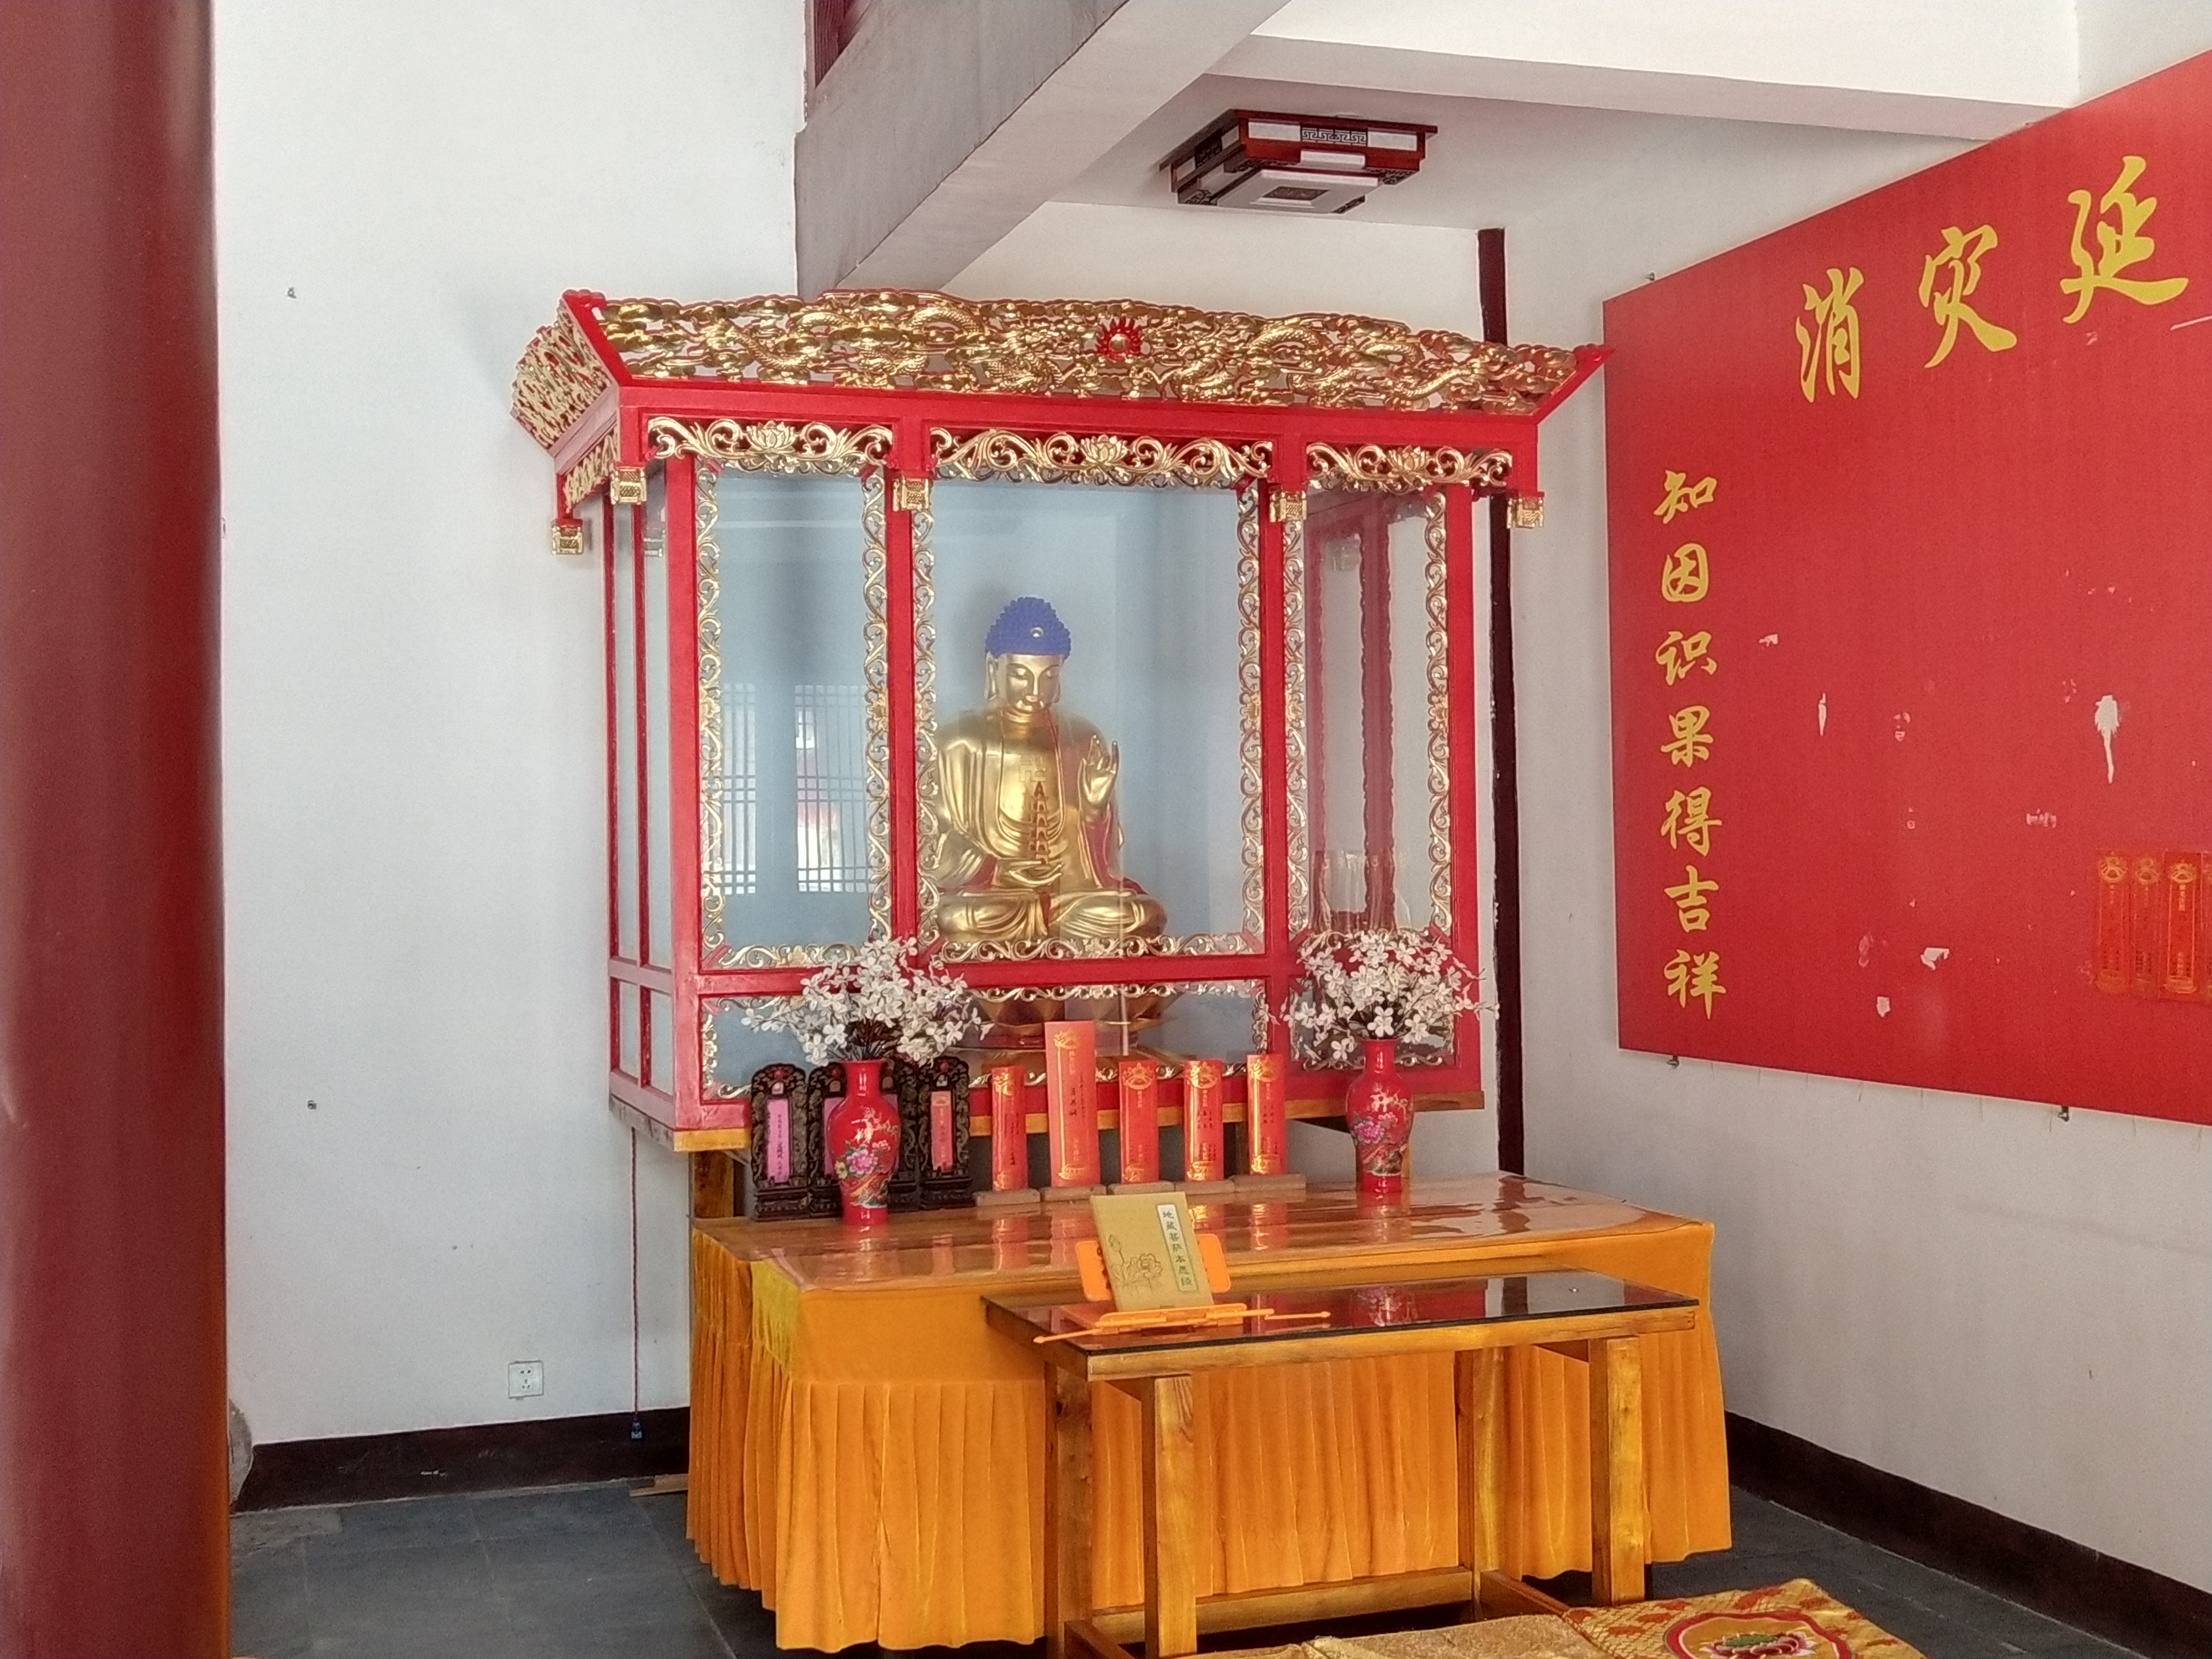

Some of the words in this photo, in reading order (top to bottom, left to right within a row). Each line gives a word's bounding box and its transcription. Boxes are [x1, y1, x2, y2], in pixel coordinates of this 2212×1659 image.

[1795, 156, 2189, 403] 消灾延
[1654, 470, 1726, 1019] 知因识果得吉祥
